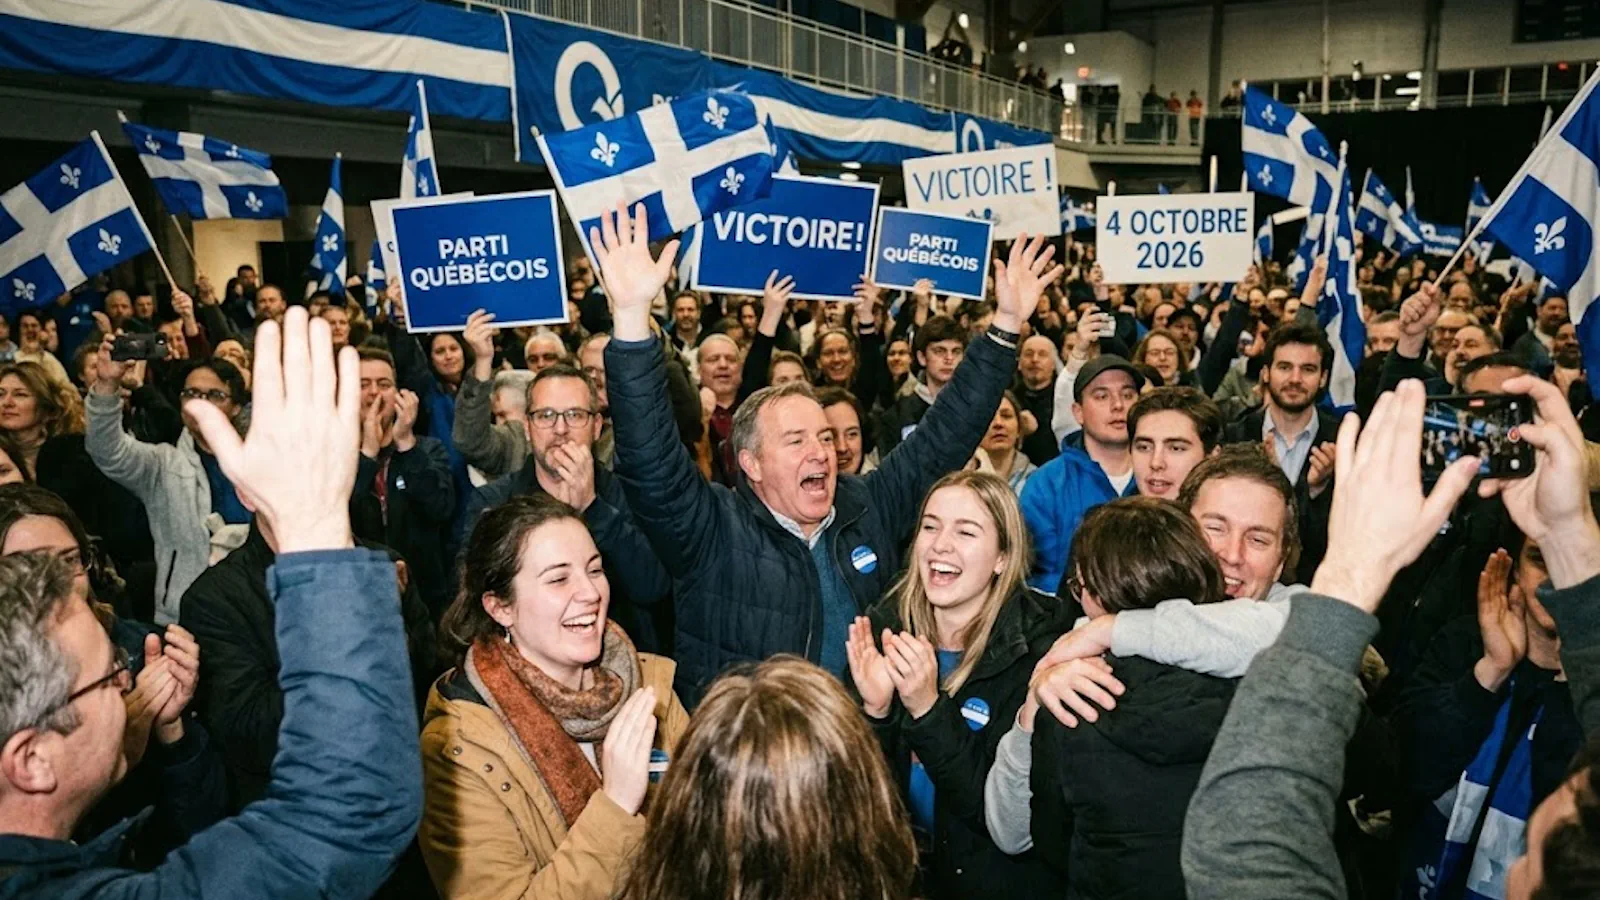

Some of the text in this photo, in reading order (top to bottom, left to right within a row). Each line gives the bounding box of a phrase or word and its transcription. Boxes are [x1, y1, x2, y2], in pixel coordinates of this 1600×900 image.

[913, 161, 1036, 202] VICTOIRE
[713, 210, 864, 252] VICTOIRE!
[1106, 208, 1247, 235] 4 OCTOBRE
[438, 234, 509, 259] PARTI
[909, 232, 958, 252] PARTI
[1137, 241, 1204, 269] 2026
[883, 247, 979, 272] QUÉBÉCOIS
[410, 257, 549, 291] QUÉBÉCOIS
